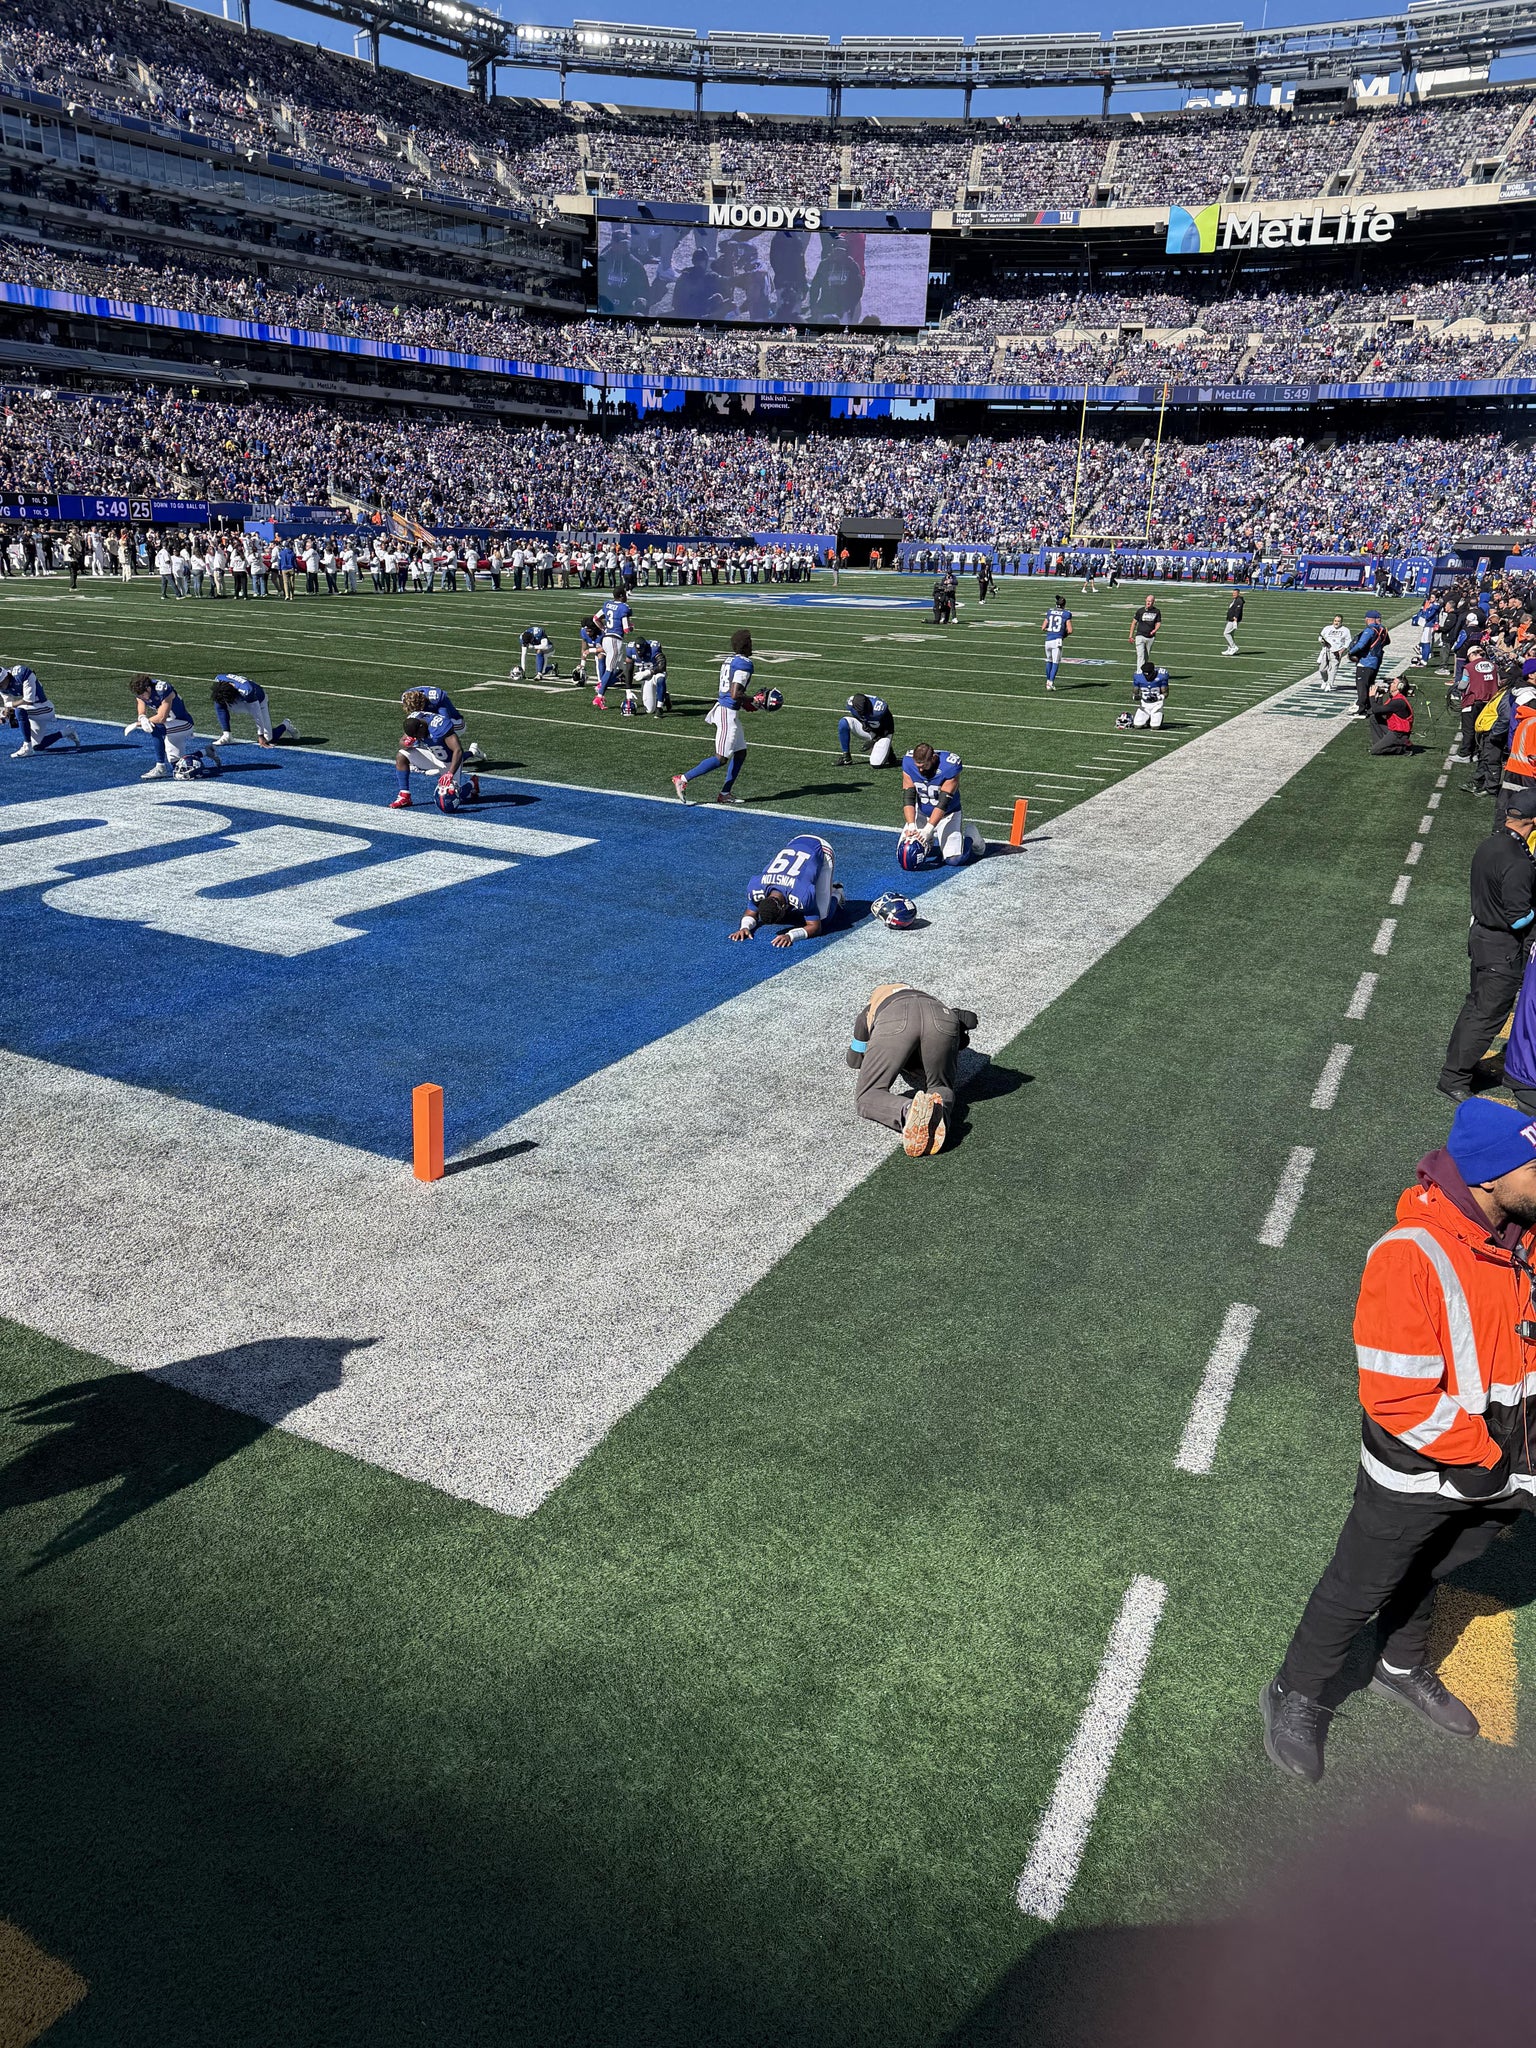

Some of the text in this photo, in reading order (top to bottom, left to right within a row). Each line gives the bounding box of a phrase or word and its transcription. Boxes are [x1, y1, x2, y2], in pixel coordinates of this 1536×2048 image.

[709, 205, 821, 229] MOODY'S
[1223, 203, 1395, 249] MetLife
[1215, 389, 1256, 400] MetLife
[1283, 388, 1309, 400] 5:49
[18, 495, 25, 505] 0
[42, 497, 48, 505] 3
[20, 507, 26, 517] 0
[44, 508, 50, 517] 3
[96, 501, 128, 517] 5:49
[132, 502, 150, 518] 25
[606, 610, 613, 629] 3
[1047, 615, 1062, 633] 13
[873, 700, 885, 712] 53
[914, 782, 942, 806] 60
[767, 849, 811, 877] 19
[761, 874, 796, 889] WINSTON
